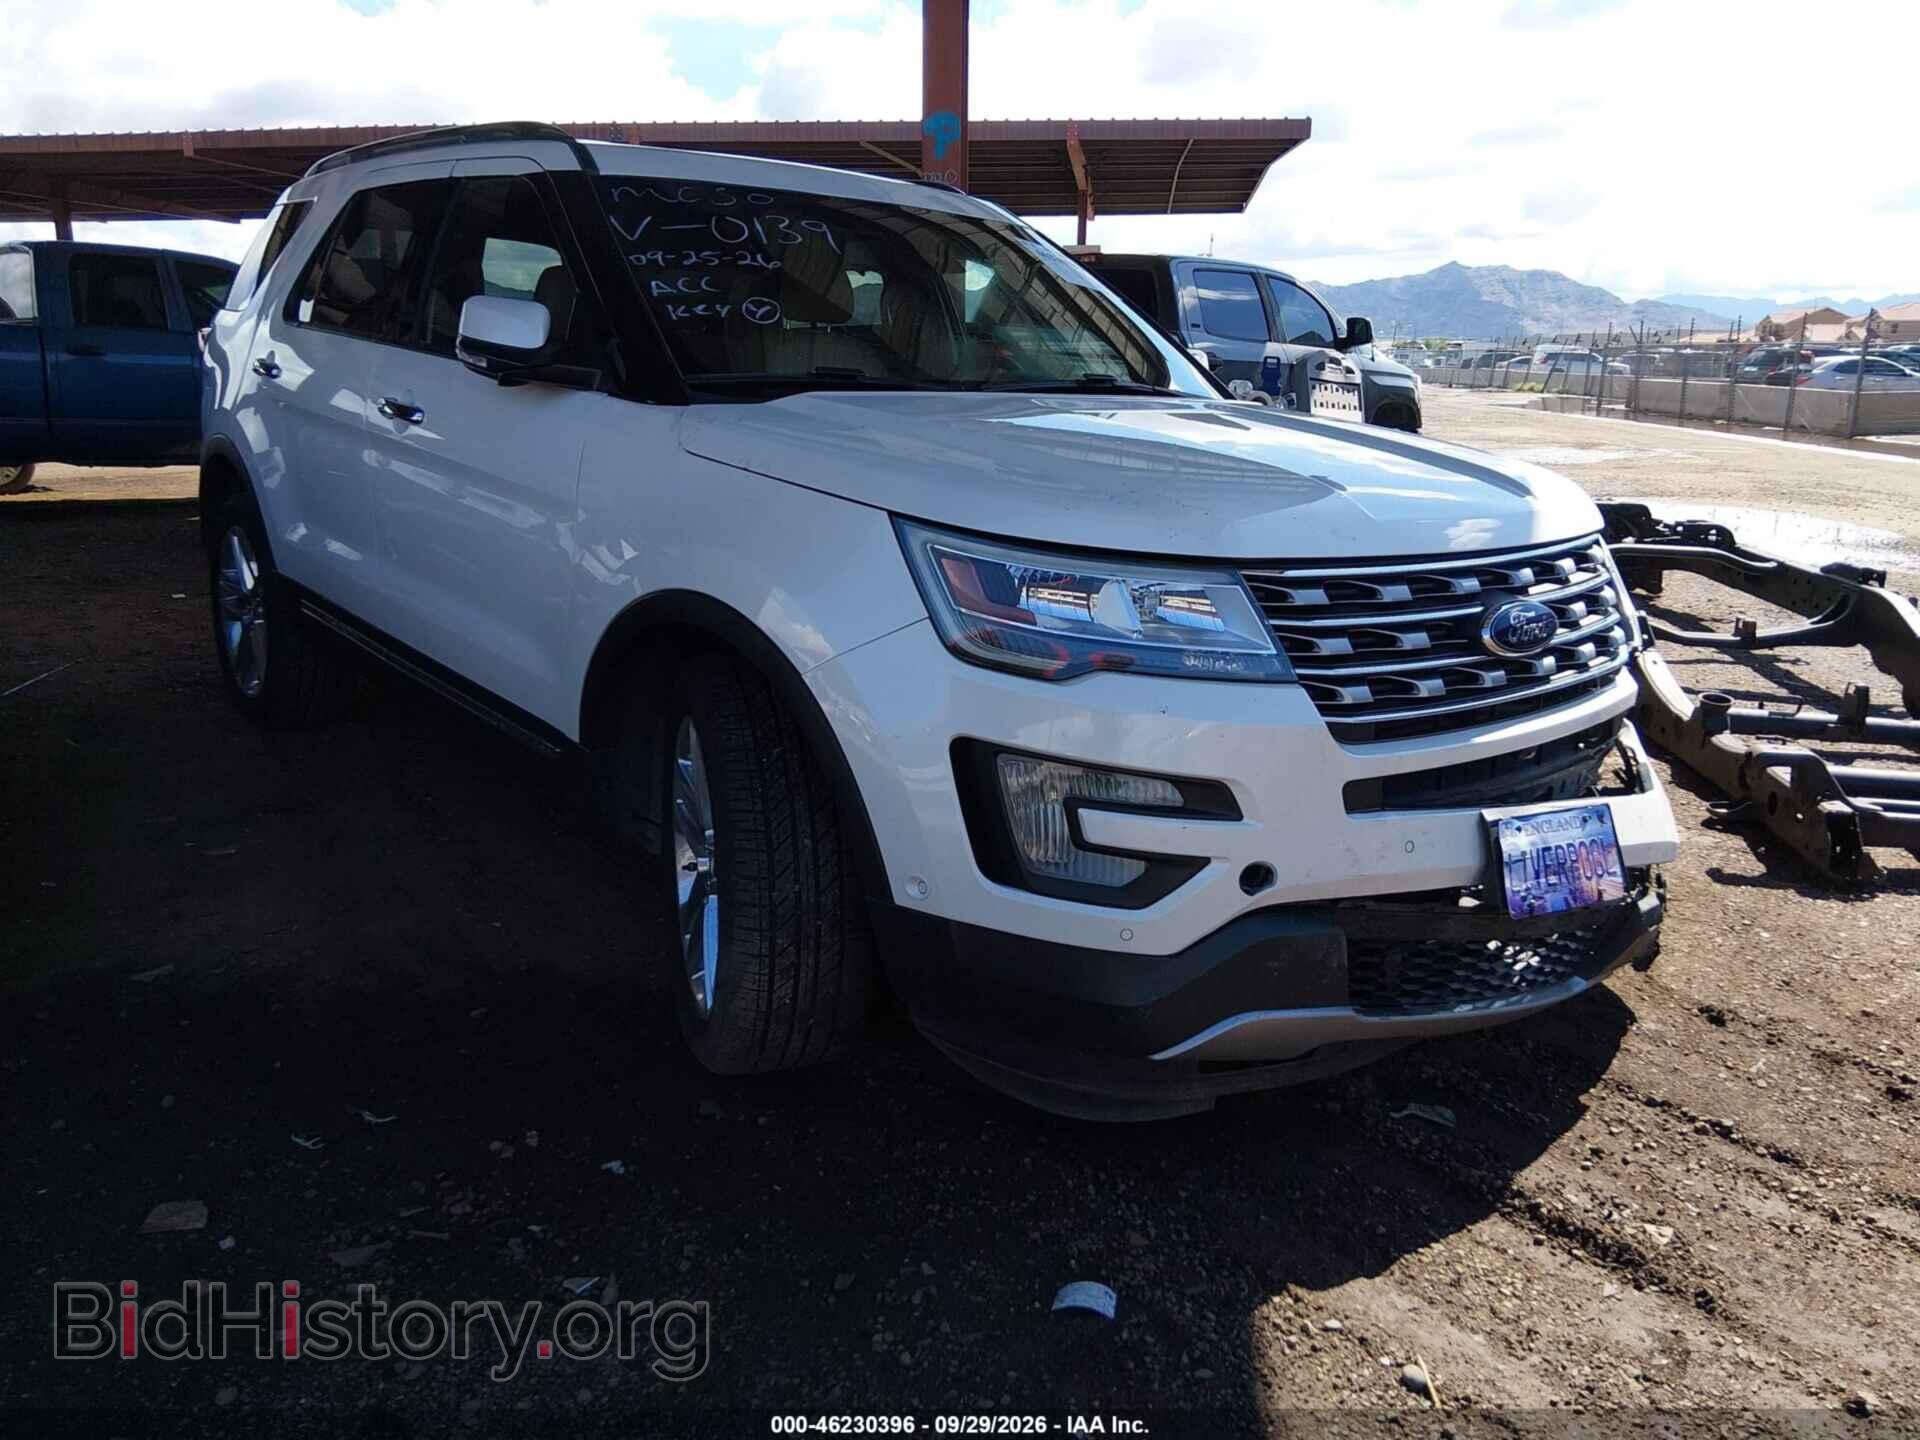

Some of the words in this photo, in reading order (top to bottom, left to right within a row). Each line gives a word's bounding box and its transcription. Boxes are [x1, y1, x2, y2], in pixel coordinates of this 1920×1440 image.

[628, 250, 782, 270] 09-25-26
[650, 276, 724, 297] ACC
[1523, 814, 1583, 838] ENGLAND
